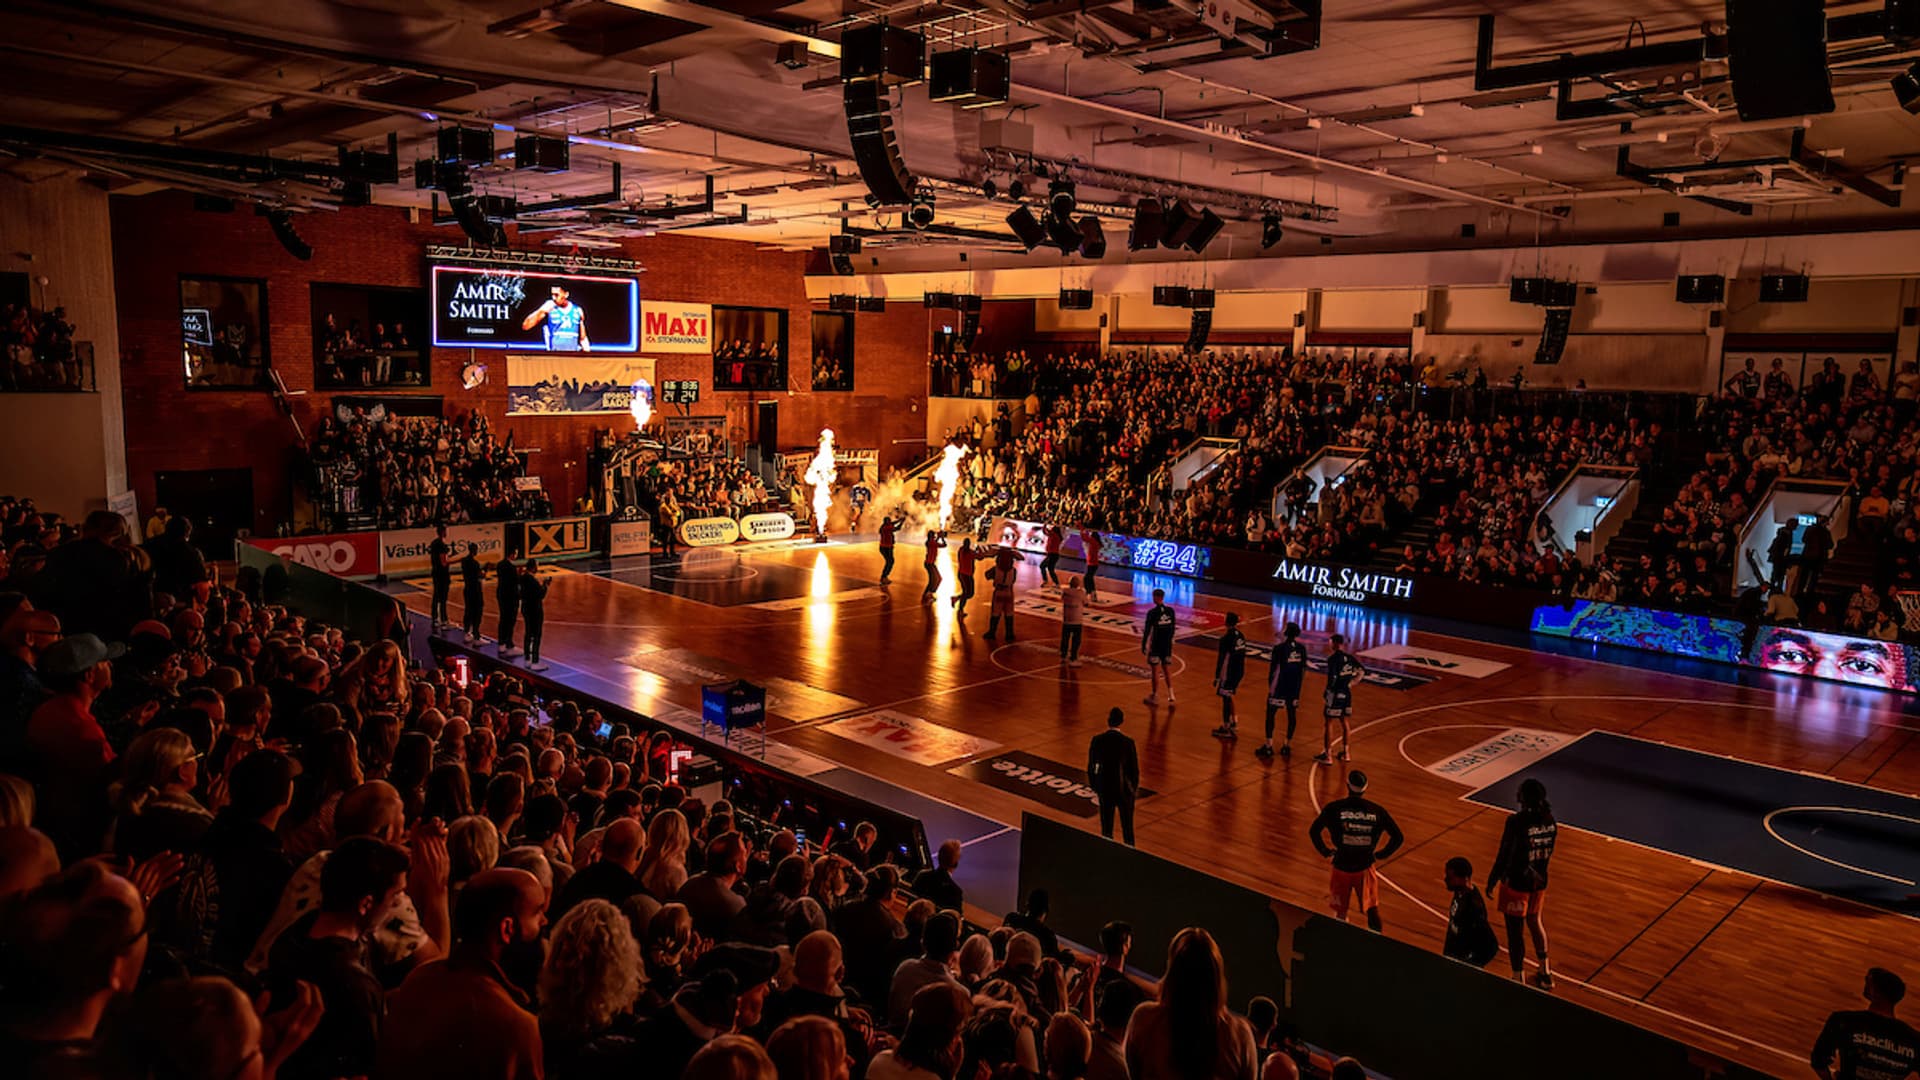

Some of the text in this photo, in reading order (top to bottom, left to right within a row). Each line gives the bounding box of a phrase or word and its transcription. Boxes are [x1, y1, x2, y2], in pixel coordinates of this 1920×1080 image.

[454, 281, 506, 301] AMIR
[449, 300, 510, 320] SMITH
[646, 311, 706, 336] MAXI
[530, 524, 585, 552] XL
[1134, 540, 1197, 574] #24
[1272, 560, 1413, 598] AMIR SMITH
[1312, 584, 1365, 601] FORWARD
[1852, 1032, 1916, 1059] stadium
